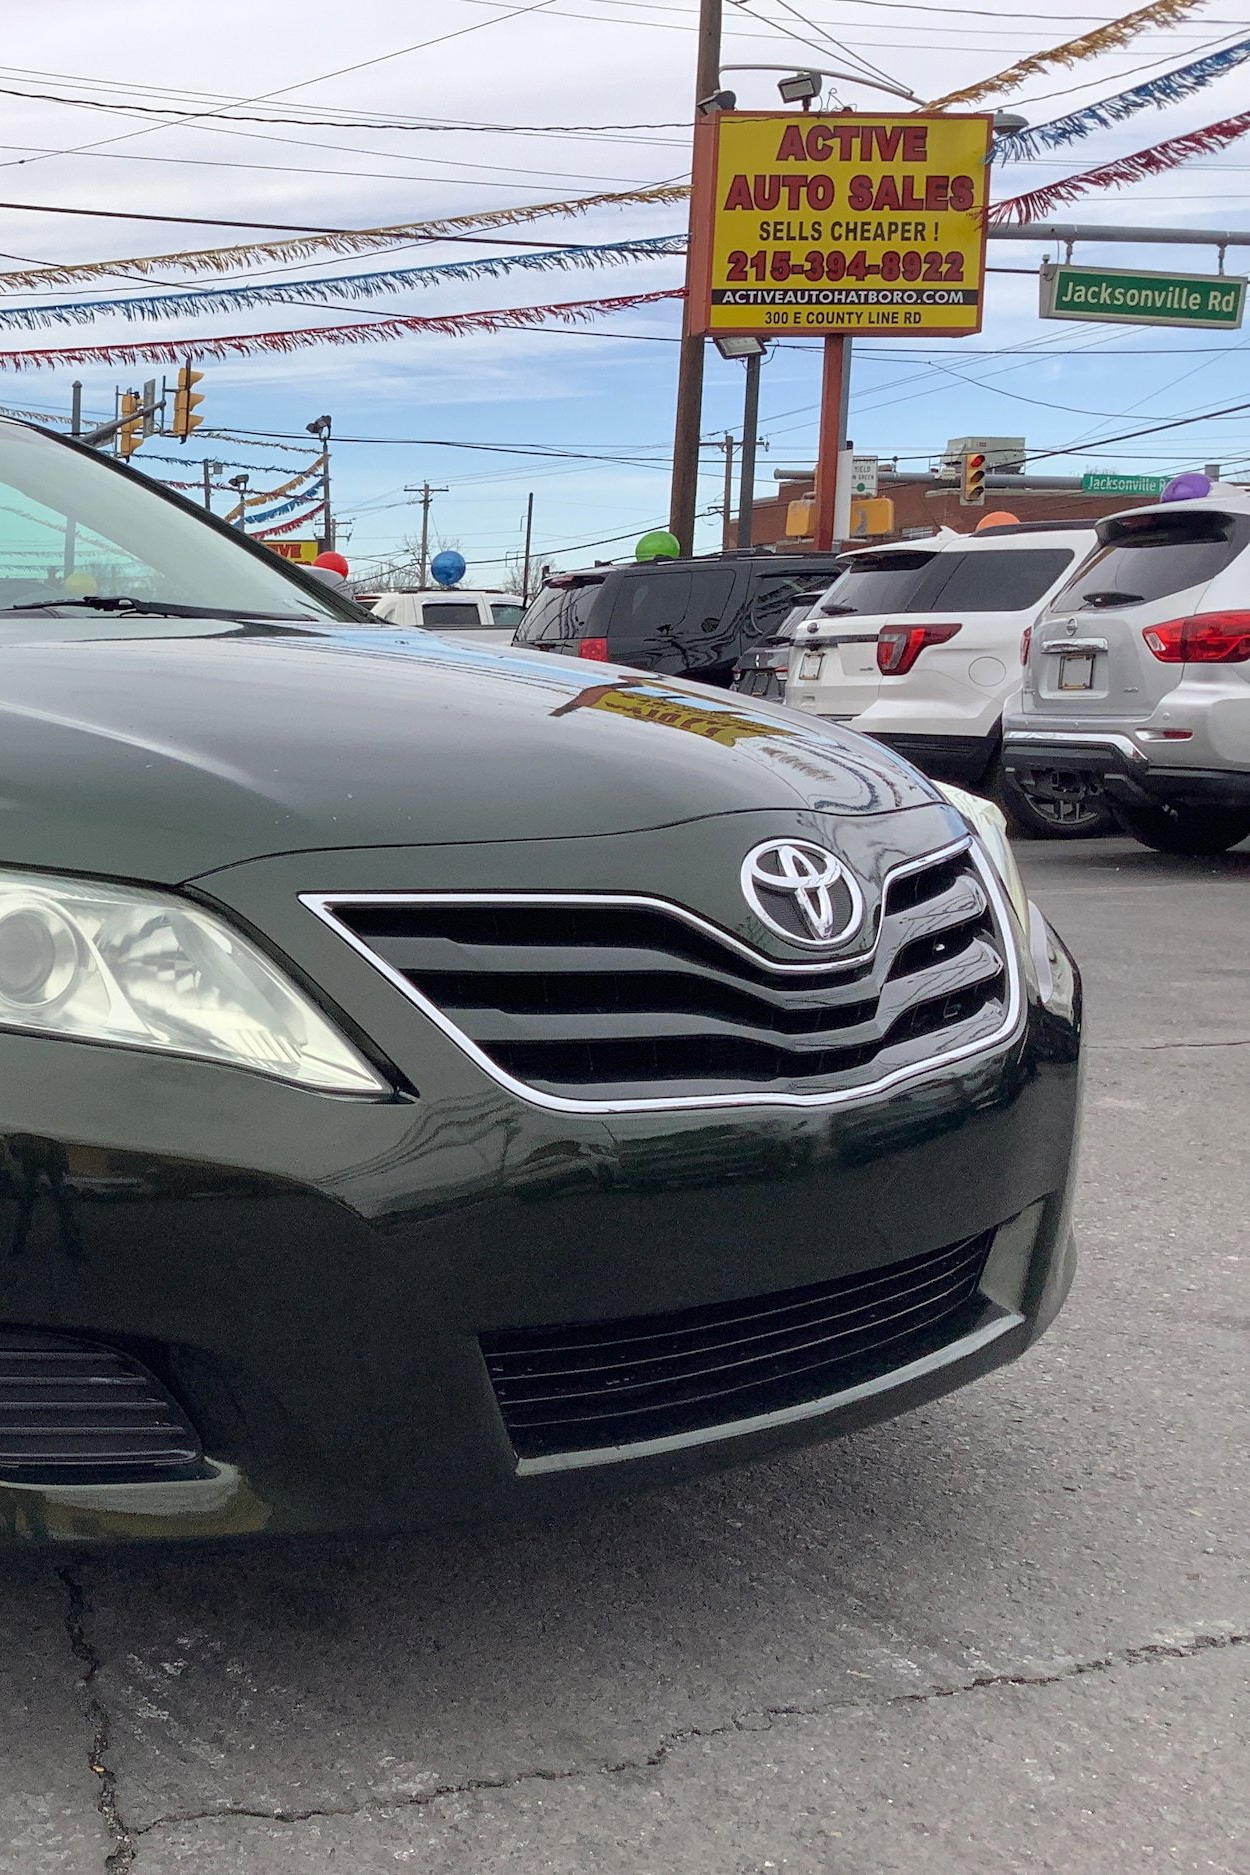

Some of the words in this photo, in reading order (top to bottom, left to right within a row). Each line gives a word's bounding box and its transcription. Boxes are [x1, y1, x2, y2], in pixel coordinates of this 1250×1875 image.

[776, 125, 928, 161] ACTIVE
[723, 174, 835, 211] AUTO
[848, 174, 975, 211] SALES
[759, 221, 823, 242] SELLS
[830, 221, 926, 242] CHEAPER
[726, 250, 964, 282] 215-394-8922
[722, 289, 964, 304] ACTIVEAUTOHATBORO.COM
[1062, 281, 1201, 310] Jacksonville
[1208, 290, 1235, 312] Rd
[765, 311, 789, 325] 300
[793, 311, 801, 325] E
[805, 311, 864, 325] COUNTY
[868, 311, 899, 325] LINE
[903, 311, 922, 325] RD
[1088, 476, 1156, 491] Jacksonville
